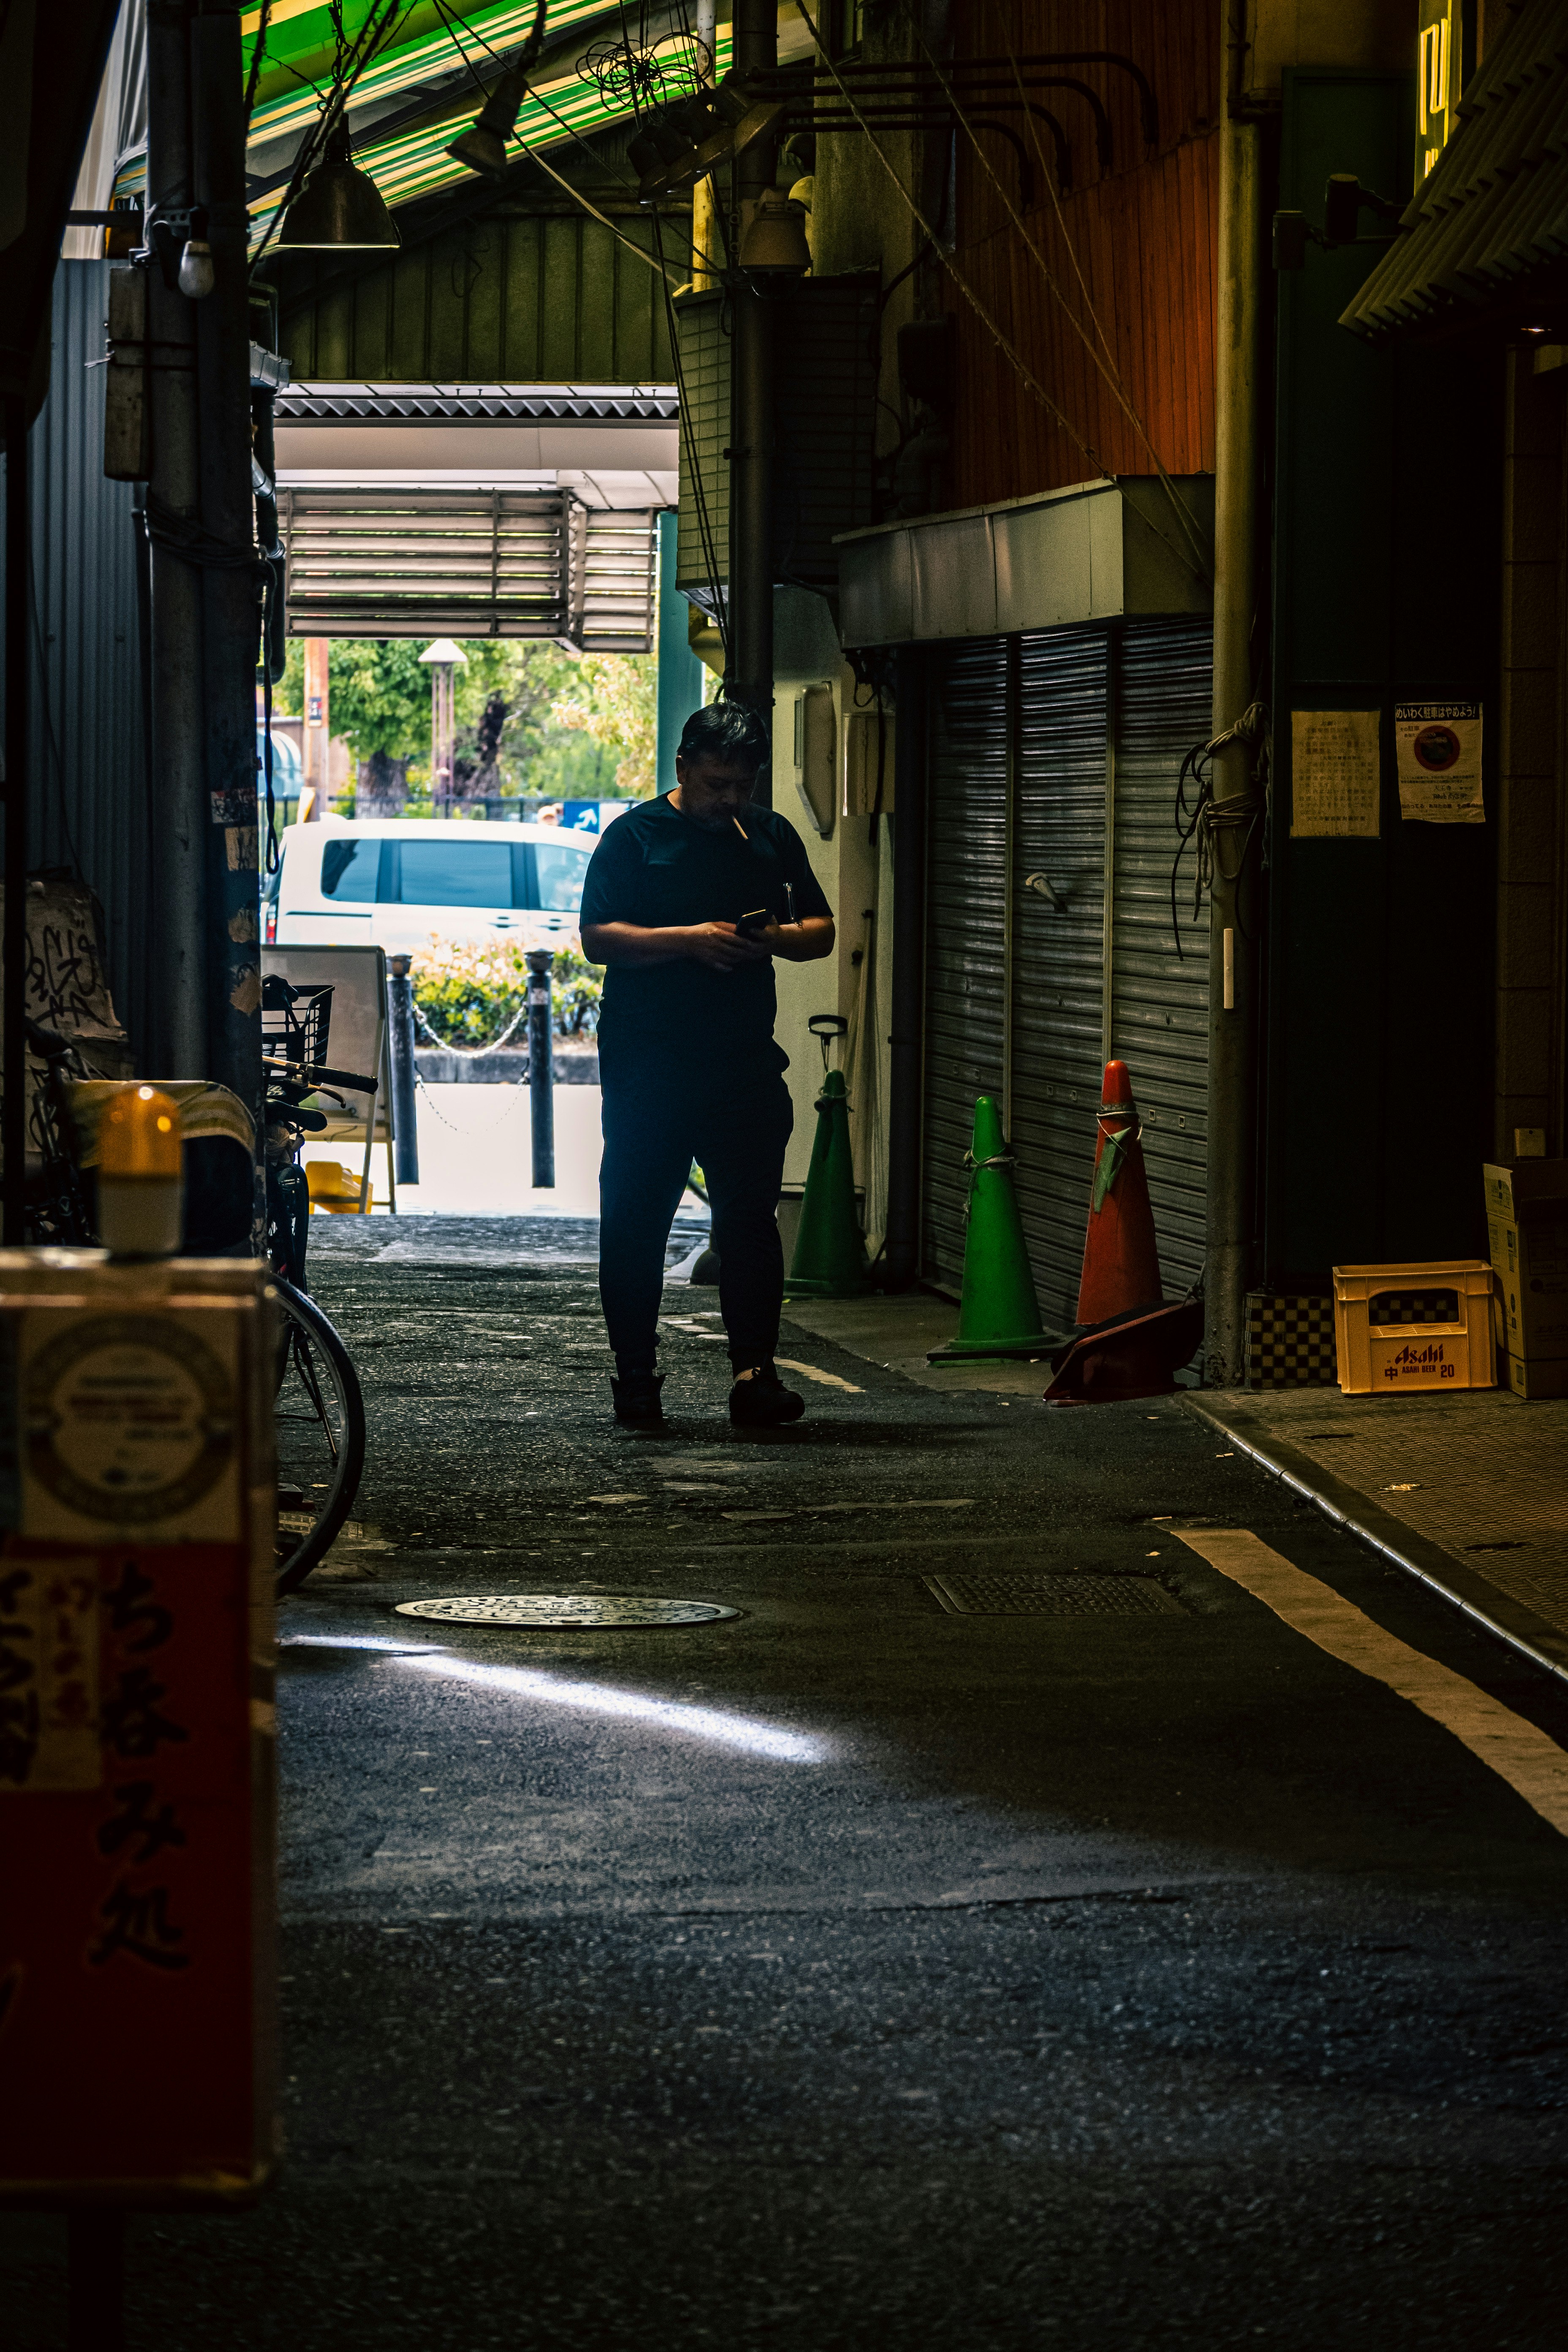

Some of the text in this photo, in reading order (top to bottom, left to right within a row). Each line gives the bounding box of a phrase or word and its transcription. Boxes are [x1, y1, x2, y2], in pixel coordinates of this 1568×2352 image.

[1396, 706, 1476, 719] めいわく駐車はやめよう!
[1395, 1343, 1444, 1365] Asahi
[1385, 1367, 1398, 1380] 中
[1440, 1364, 1454, 1378] 20
